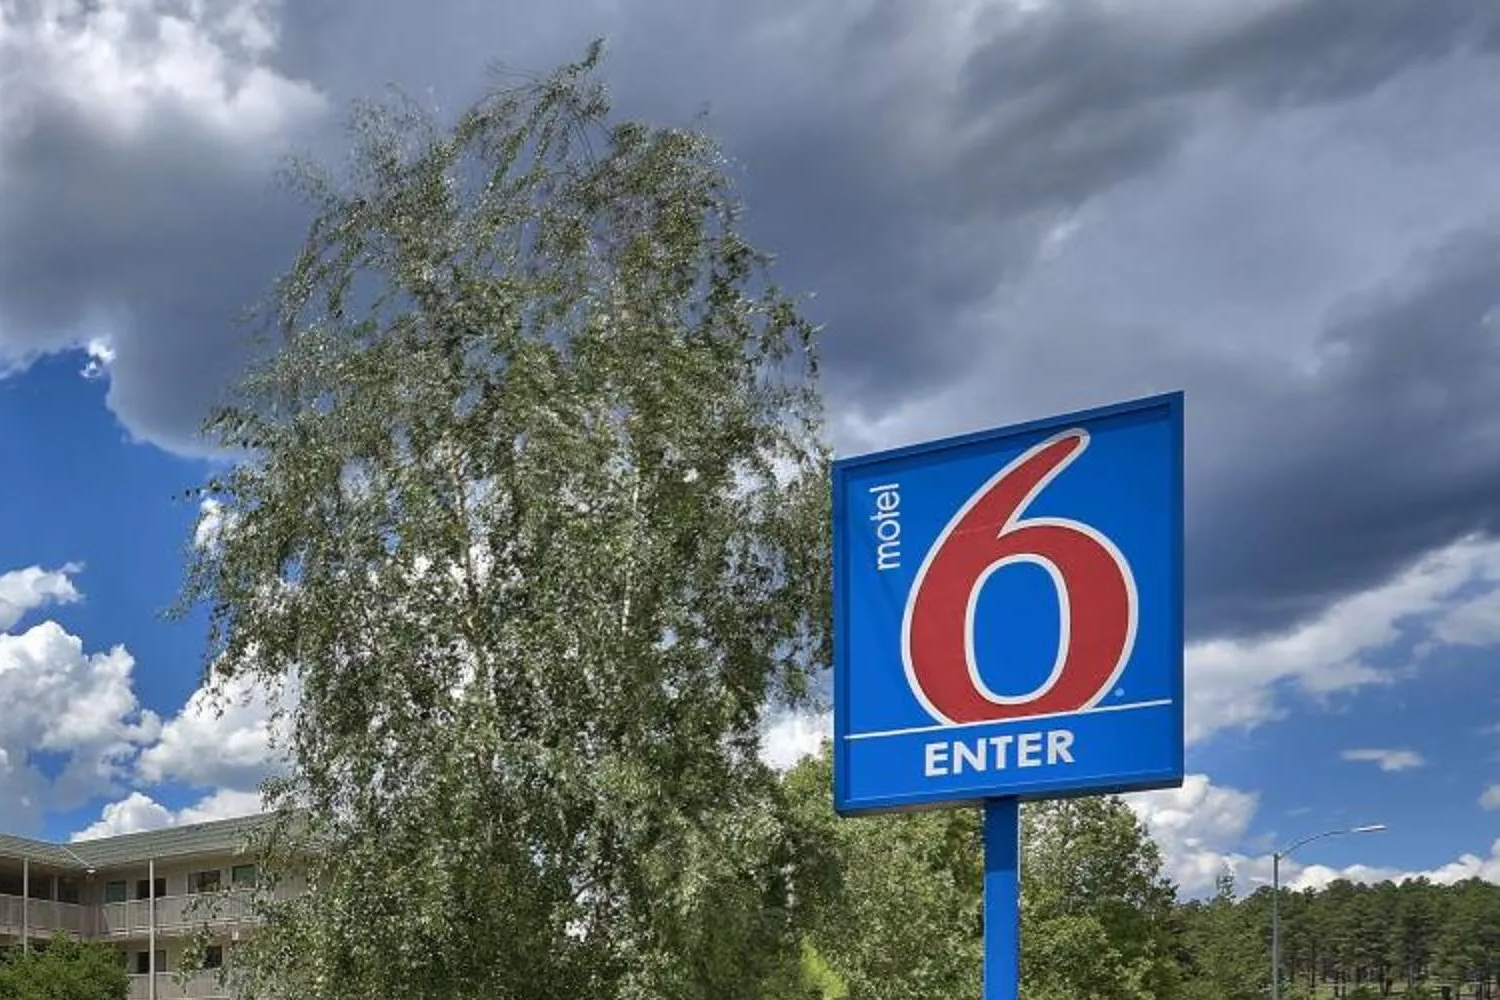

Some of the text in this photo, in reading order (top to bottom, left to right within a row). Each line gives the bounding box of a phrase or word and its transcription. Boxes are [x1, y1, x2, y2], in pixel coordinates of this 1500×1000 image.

[869, 427, 1139, 724] motel 6
[924, 729, 1075, 777] ENTER
